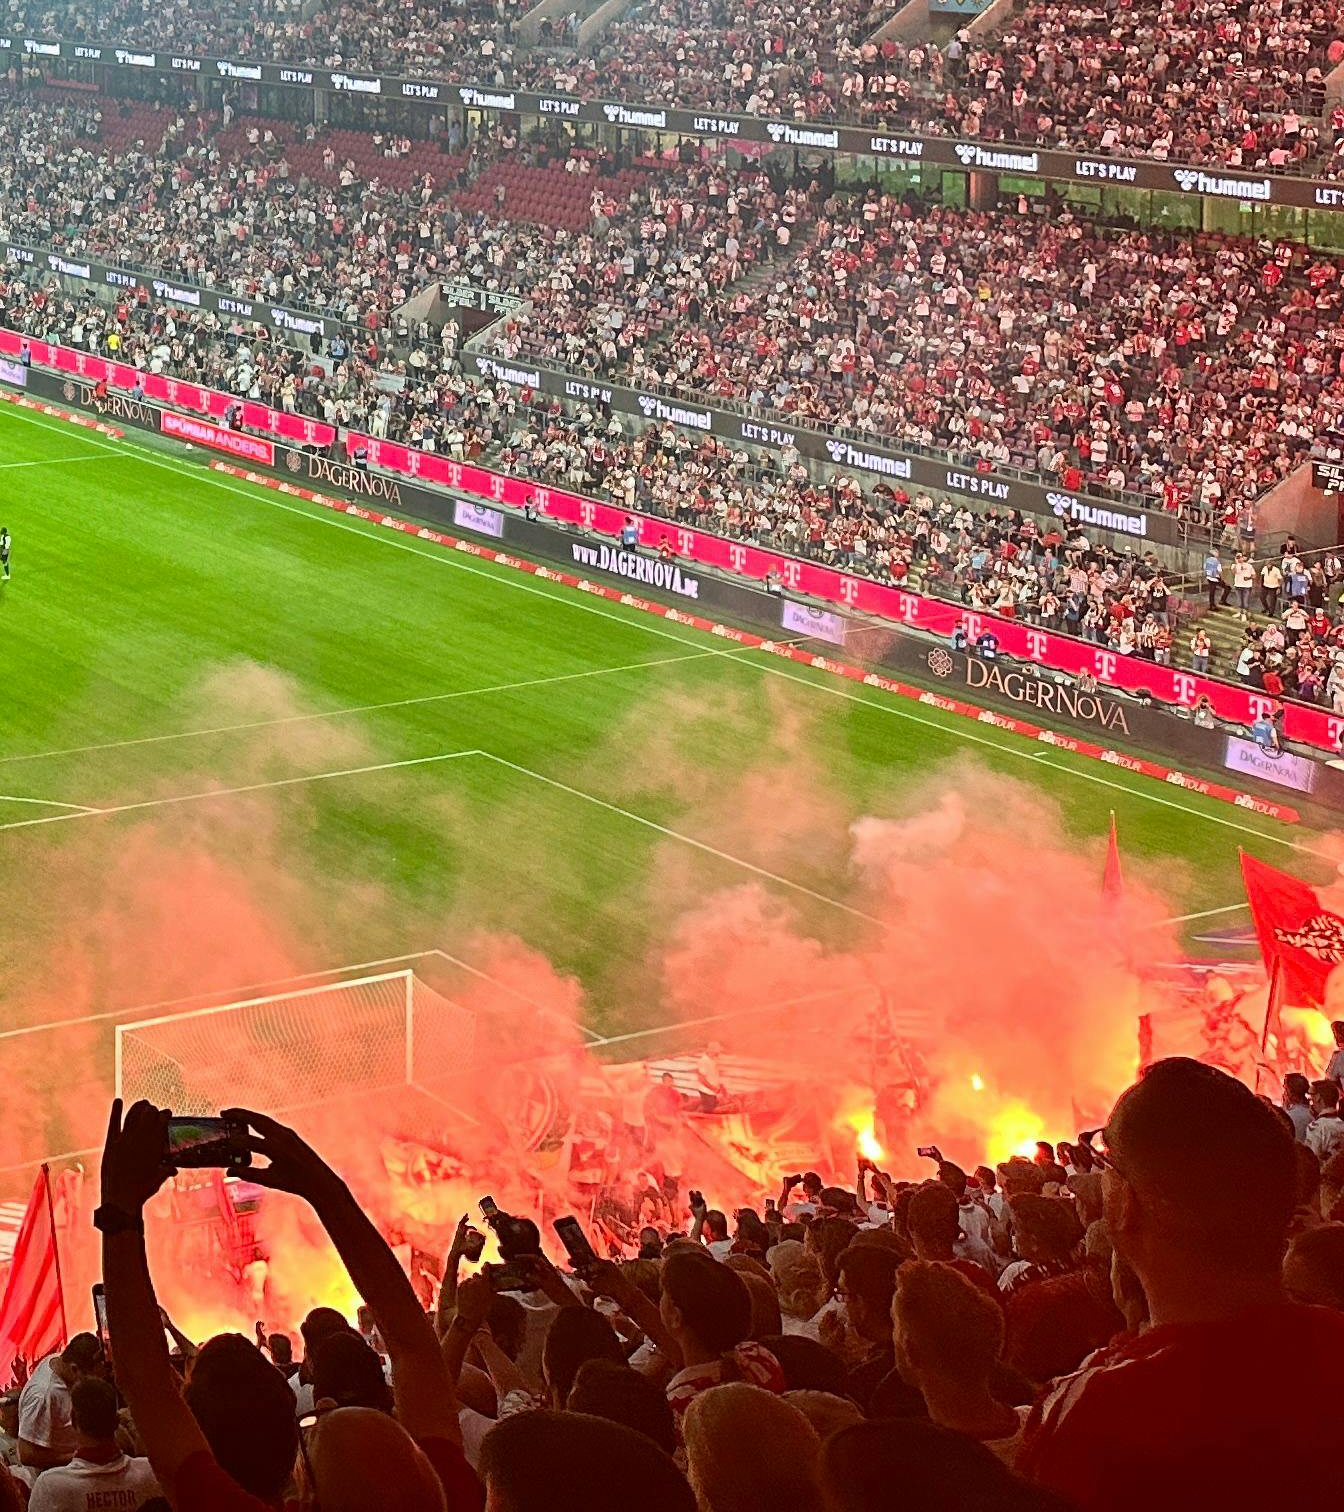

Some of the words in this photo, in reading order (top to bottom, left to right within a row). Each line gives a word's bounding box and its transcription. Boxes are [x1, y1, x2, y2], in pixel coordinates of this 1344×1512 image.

[280, 70, 297, 82] LET'S
[297, 72, 313, 84] PLAY
[402, 83, 421, 96] LET'S
[421, 86, 439, 98] PLAY
[474, 93, 515, 110] hummel
[540, 99, 560, 114] LET'S
[561, 102, 580, 116] PLAY
[619, 108, 666, 128] hummel
[694, 117, 717, 131] LET'S
[718, 121, 740, 134] PLAY
[785, 128, 838, 148] hummel
[871, 137, 897, 152] LET'S
[899, 141, 923, 156] PLAY
[975, 151, 1038, 173] hummel
[1076, 161, 1106, 178] LET'S
[1108, 164, 1136, 182] PLAY
[1198, 176, 1271, 200] hummel
[492, 362, 540, 389] hummel
[565, 381, 589, 399] LET'S
[656, 403, 712, 430] hummel
[164, 416, 216, 444] SPÜRBAR
[741, 422, 769, 441] LET'S
[847, 445, 911, 478] hummel
[308, 455, 403, 506] DAGERNOVA
[947, 471, 978, 491] LET'S
[980, 480, 1010, 500] PLAY
[1071, 498, 1146, 536] hummel
[965, 656, 1132, 736] DAGERNOVA
[1239, 748, 1300, 782] DAGERNOVA
[86, 1489, 138, 1509] HECTOR
